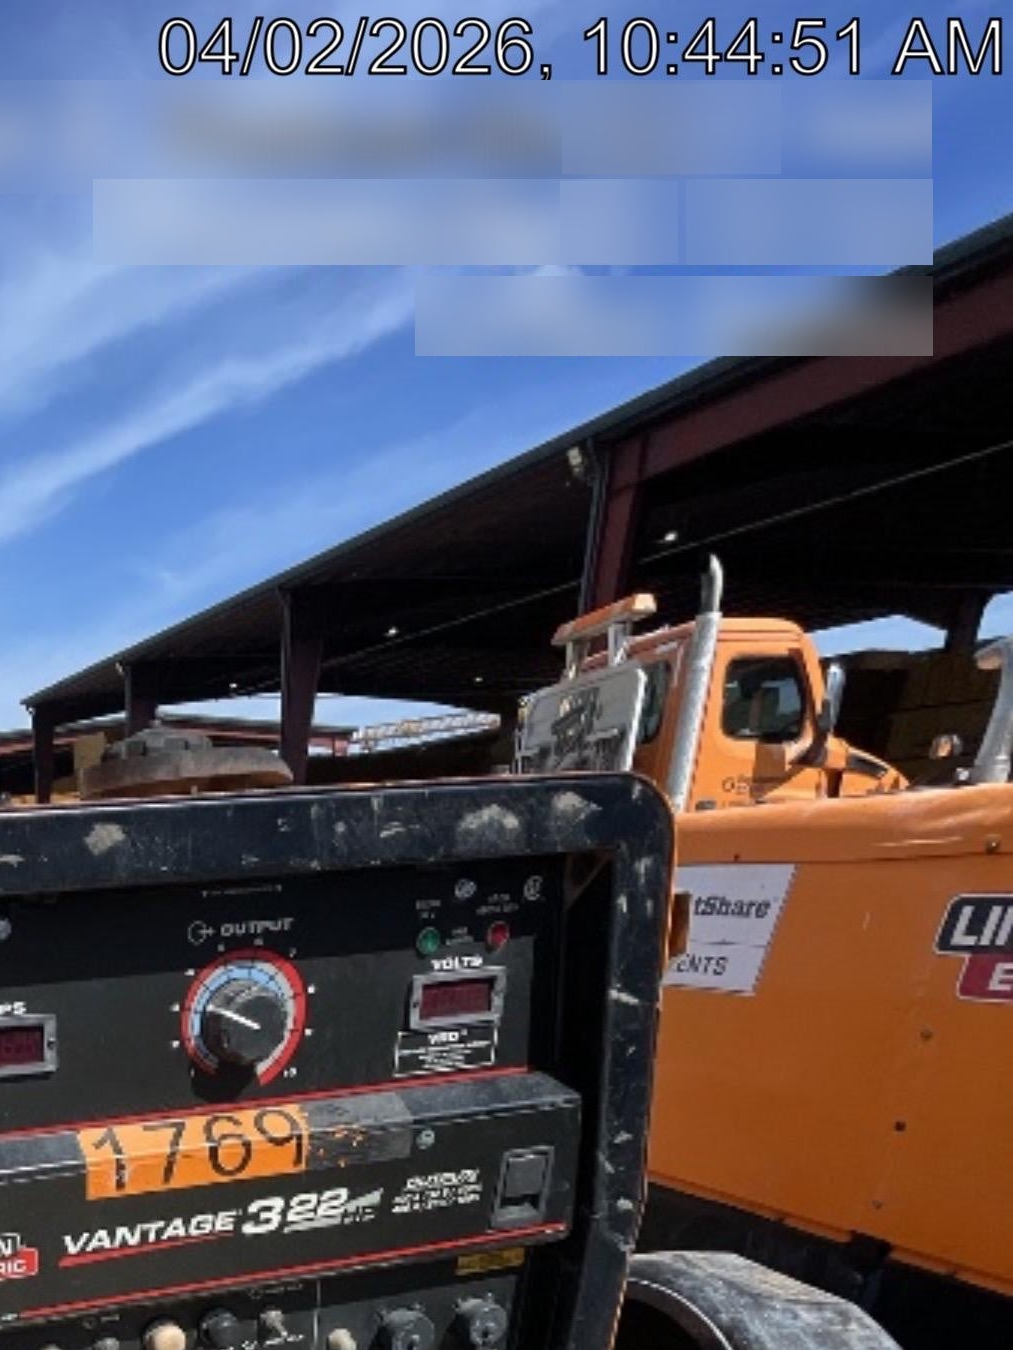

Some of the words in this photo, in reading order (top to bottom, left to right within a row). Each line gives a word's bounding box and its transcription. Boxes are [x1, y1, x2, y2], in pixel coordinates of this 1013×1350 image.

[220, 917, 295, 937] OUTPUT
[431, 955, 484, 971] VOLTS
[91, 1109, 304, 1192] 1769
[62, 1210, 238, 1255] VANTAGE
[241, 1187, 349, 1235] 322
